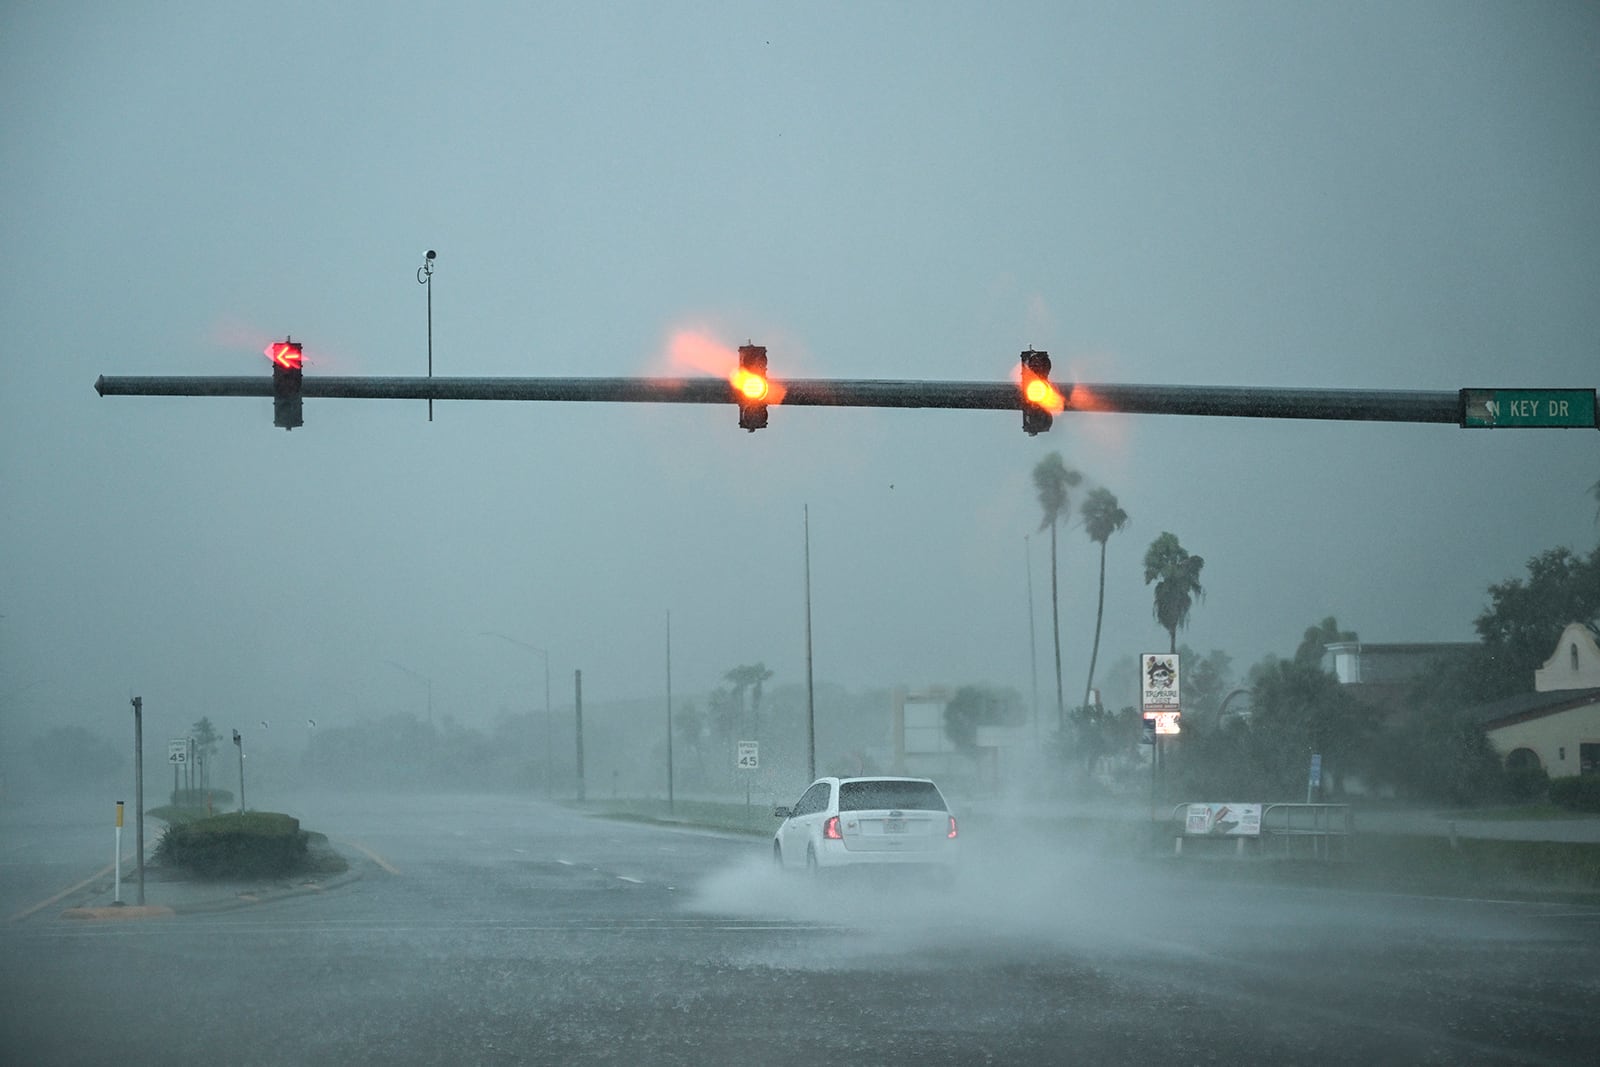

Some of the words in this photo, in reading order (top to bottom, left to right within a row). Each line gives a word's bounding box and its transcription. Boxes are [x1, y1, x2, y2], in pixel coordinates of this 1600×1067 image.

[1510, 400, 1539, 417] KEY
[1549, 400, 1569, 417] DR
[1144, 690, 1178, 698] TREASURE
[170, 753, 185, 762] 45
[740, 756, 757, 767] 45
